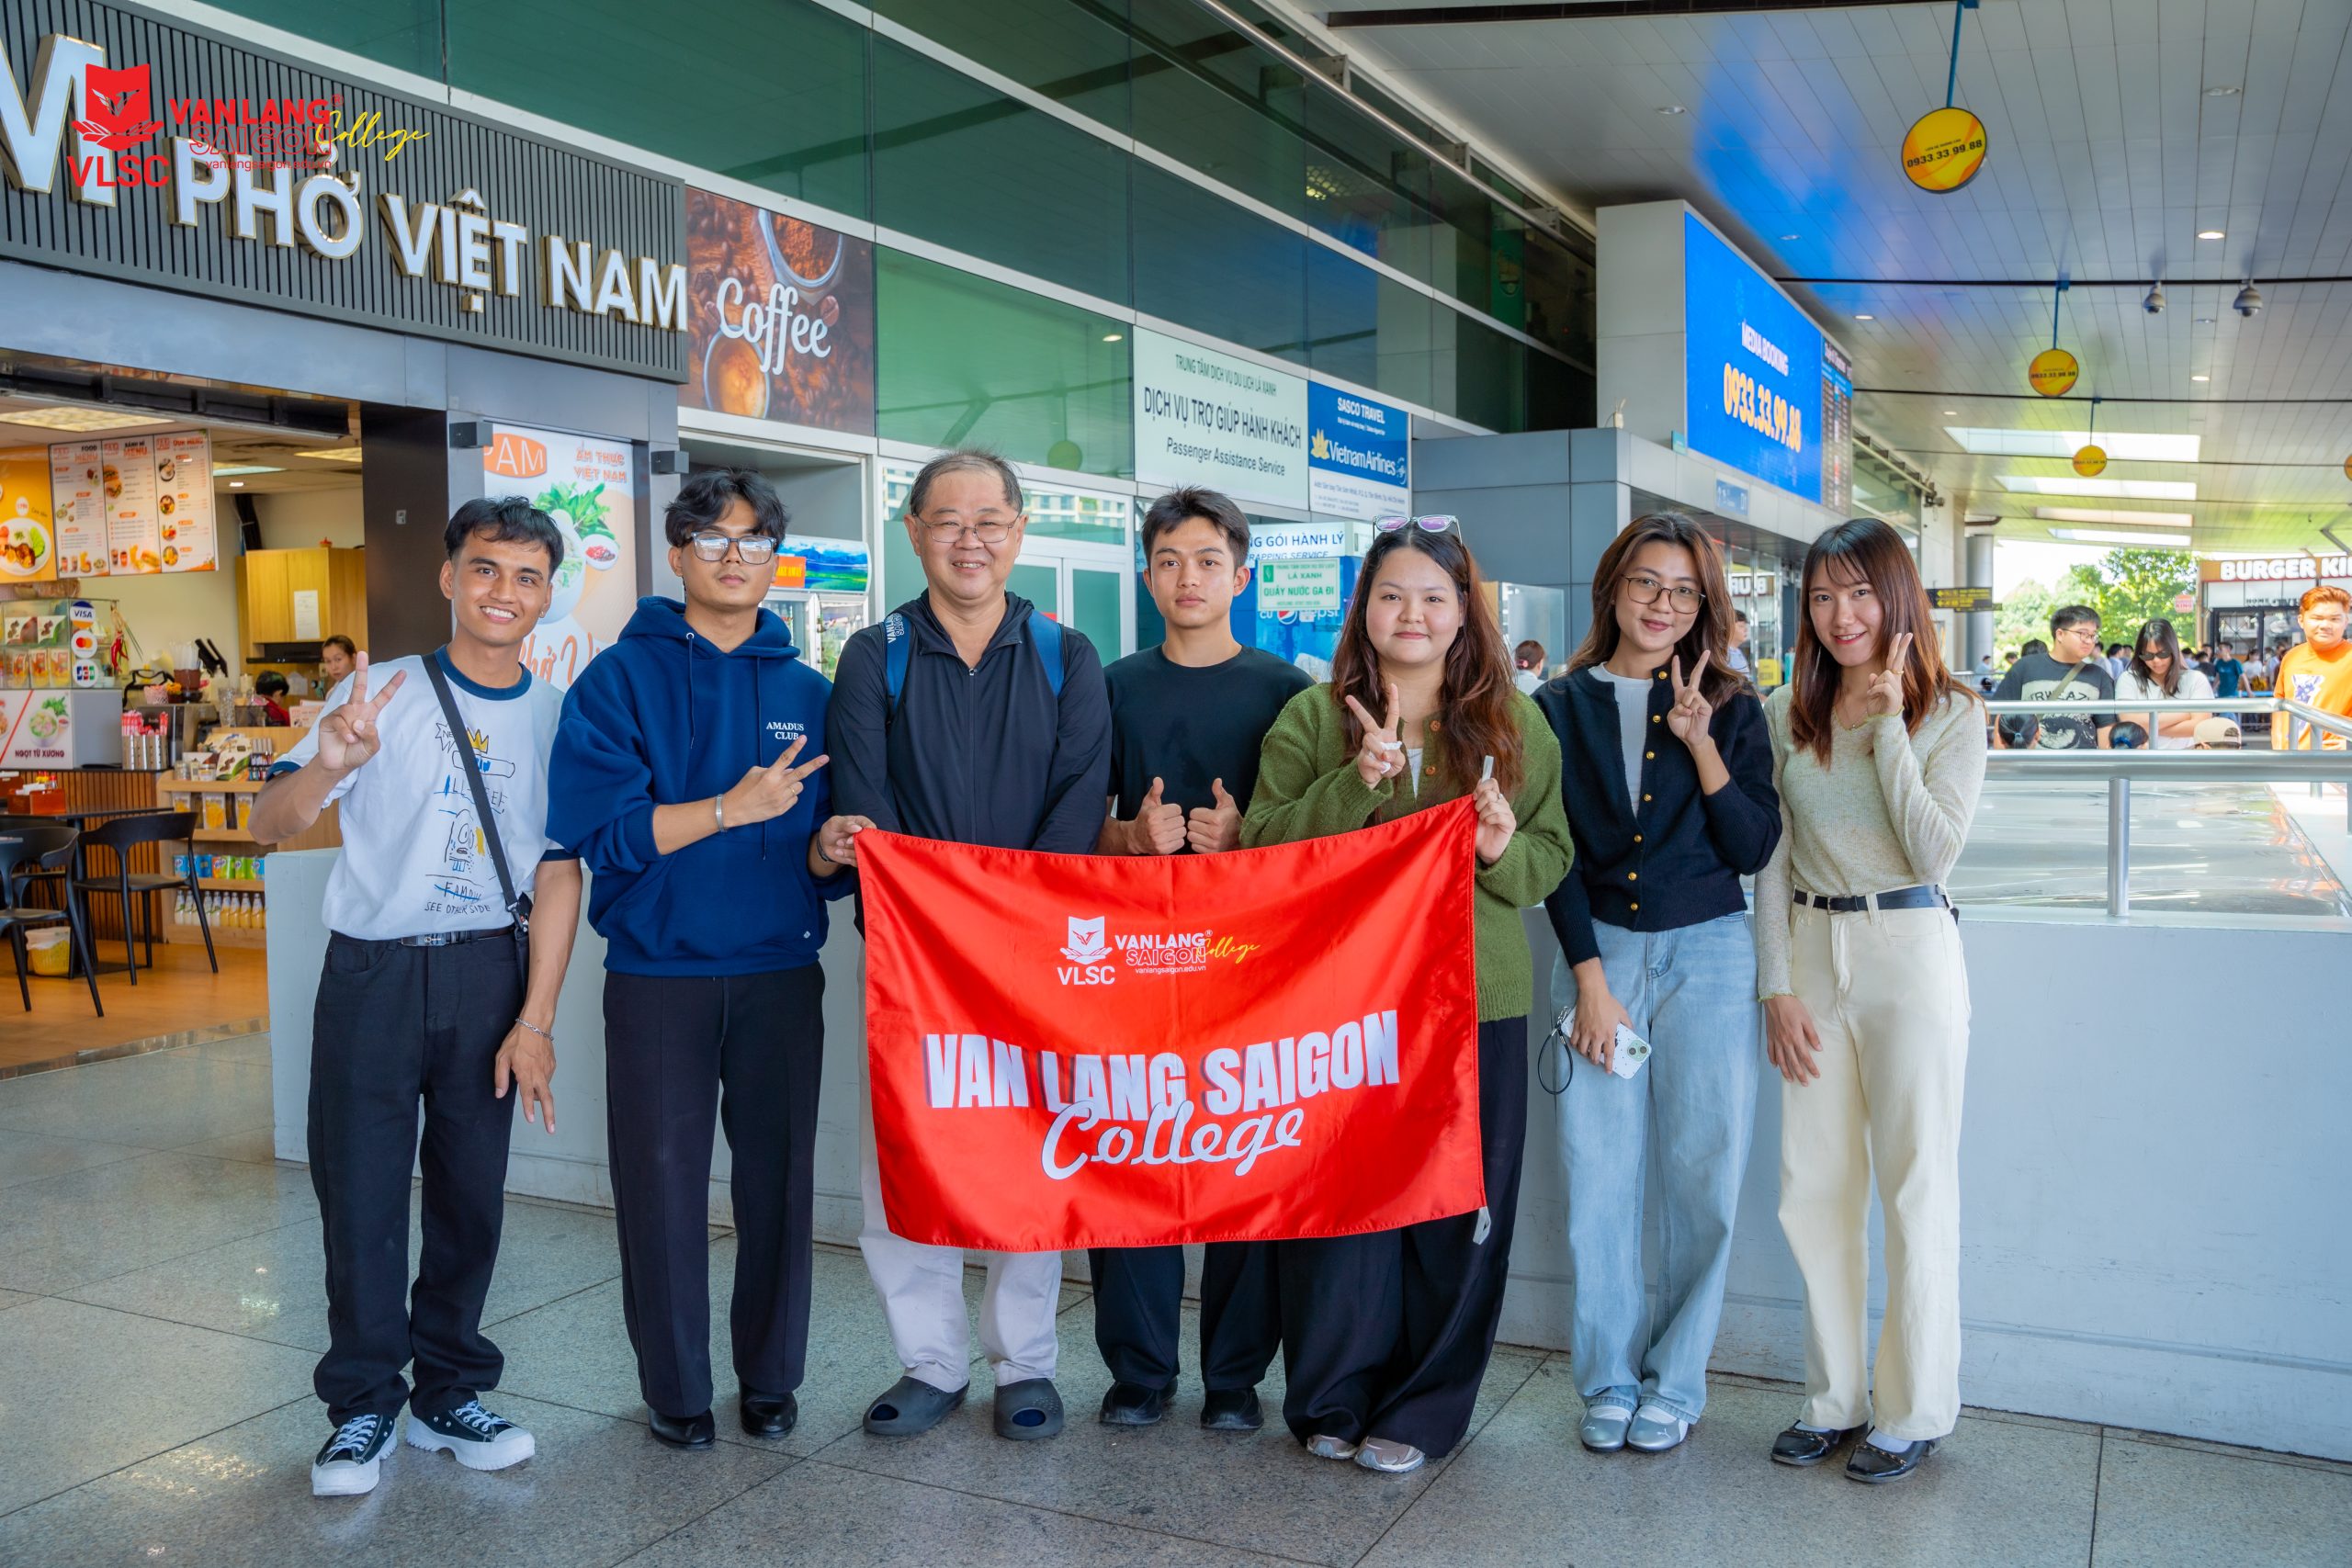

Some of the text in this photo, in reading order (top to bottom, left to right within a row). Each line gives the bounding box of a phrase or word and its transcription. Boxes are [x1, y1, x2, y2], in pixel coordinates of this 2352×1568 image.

[379, 187, 528, 314] VIỆT
[542, 234, 689, 333] NAM
[717, 277, 831, 375] Coffee
[1741, 320, 1762, 357] MEDIA
[1762, 337, 1789, 377] BOOKING
[1175, 354, 1196, 374] TRUNG
[1145, 387, 1171, 422] DỊCH
[1174, 394, 1189, 428] VỤ
[1192, 399, 1214, 434] TRỢ
[1216, 401, 1240, 434] GIÚP
[1242, 407, 1268, 441] HÀNH
[1271, 416, 1301, 449] KHÁCH
[1338, 397, 1385, 424] SASCO TRAVEL
[1724, 362, 1802, 453] 0933.33.99.88
[1167, 437, 1285, 476] Passenger Assistance Service
[603, 469, 628, 483] NAM
[1266, 533, 1287, 547] GÓI
[1292, 532, 1328, 546] HÀNH
[1332, 530, 1344, 545] LÝ
[1250, 551, 1329, 560] RAPPING SERVICE
[2220, 557, 2316, 581] BURGER
[1312, 586, 1323, 595] GA
[74, 610, 93, 618] VISA
[765, 721, 805, 731] AMADUS
[775, 731, 799, 740] CLUB
[424, 901, 442, 912] SEE
[469, 904, 492, 914] SIDE
[1125, 945, 1206, 966] SAIGON
[1196, 936, 1261, 964] College
[1057, 965, 1116, 986] VLSC
[1135, 964, 1206, 976] vanlangsaigon.edu.vn
[925, 1010, 1400, 1122] VAN LANG SAIGON
[1040, 1099, 1306, 1181] College
